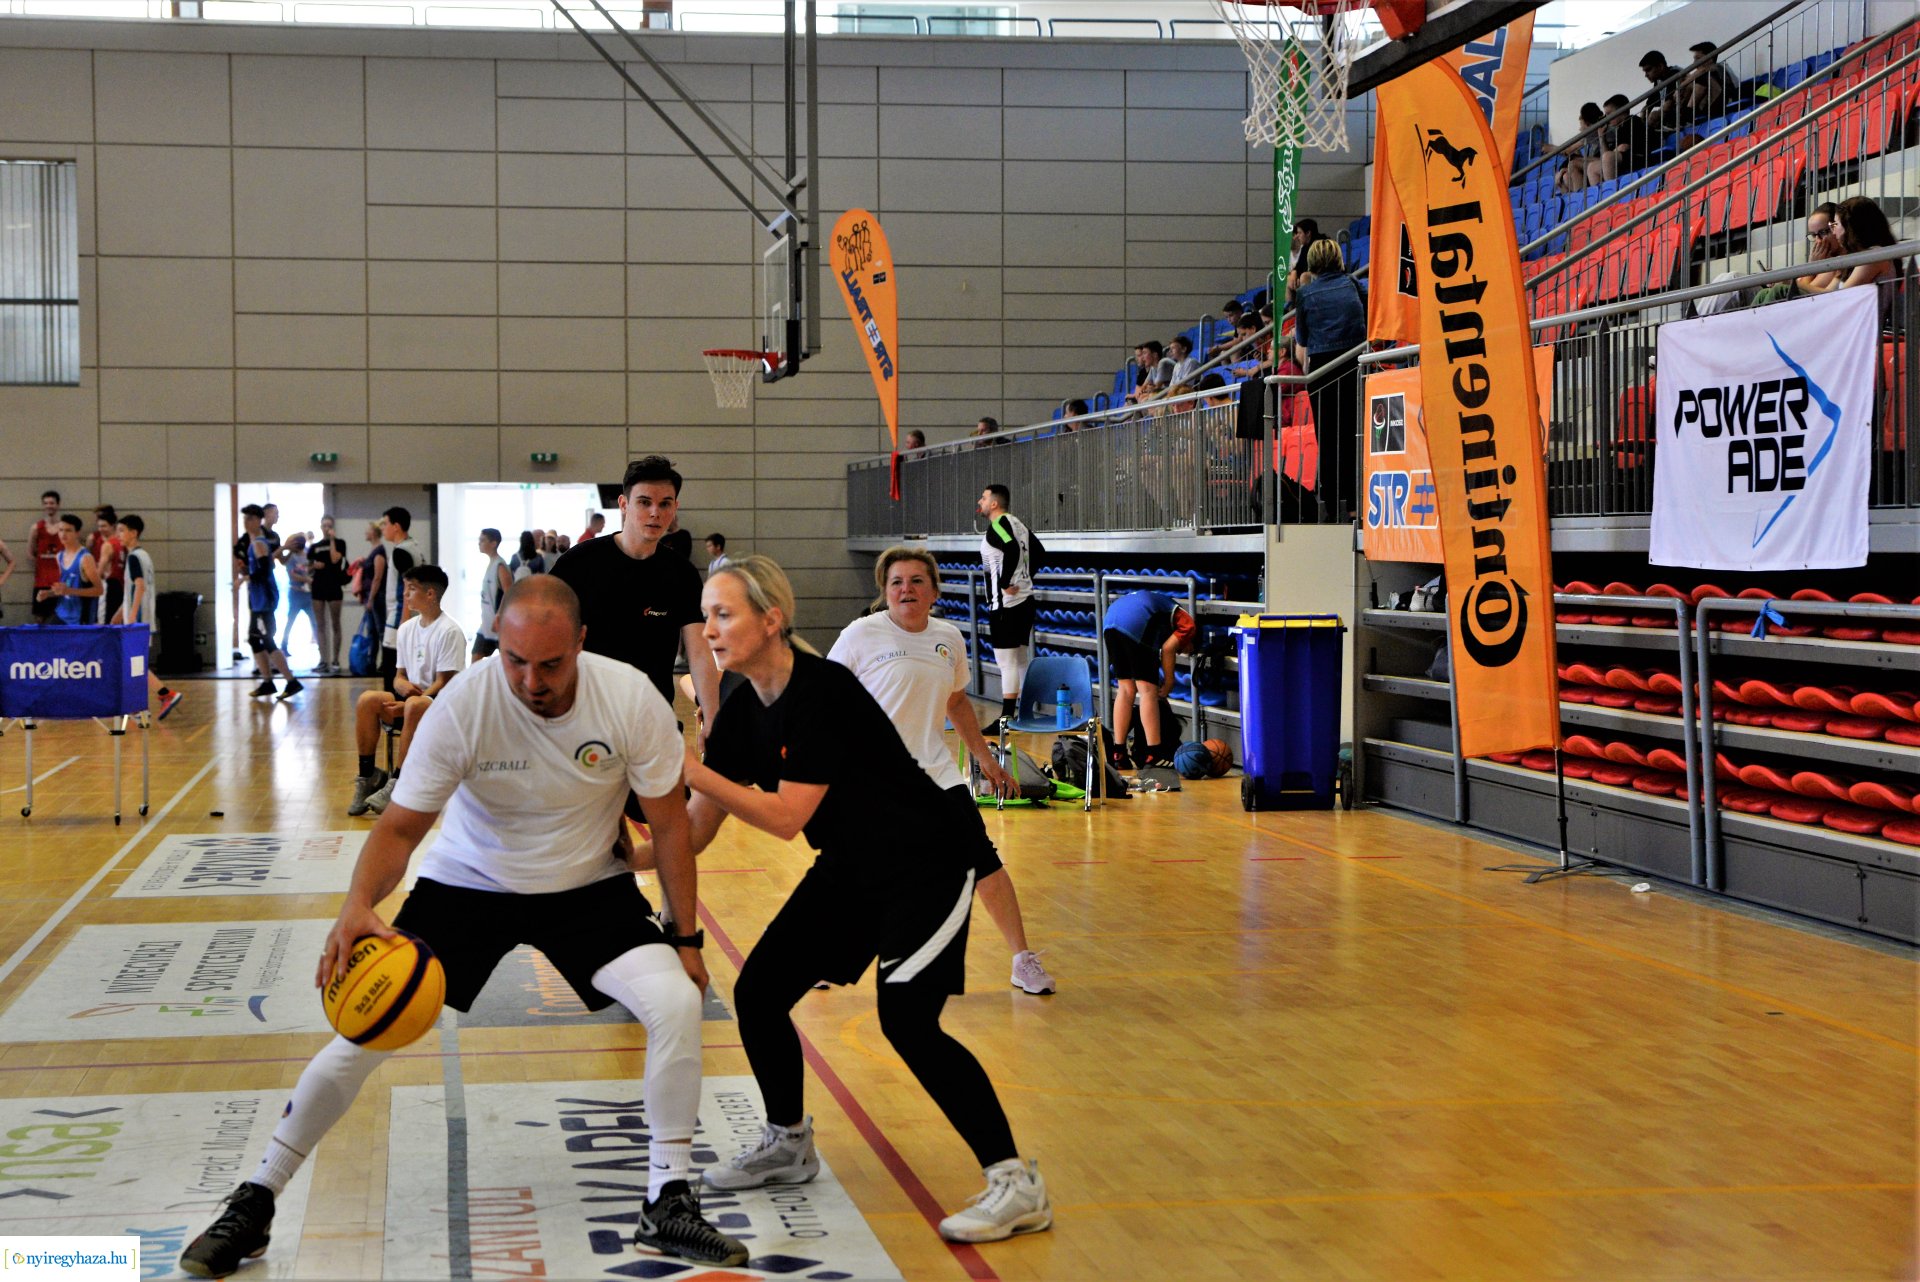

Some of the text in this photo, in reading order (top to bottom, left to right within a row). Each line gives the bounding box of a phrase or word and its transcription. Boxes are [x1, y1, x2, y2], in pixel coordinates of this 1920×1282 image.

[1674, 376, 1809, 439] POWER
[1728, 434, 1806, 494] ADE
[10, 657, 102, 680] molten
[101, 940, 183, 994] NYÍREGYHÁZI
[184, 928, 257, 992] SPORTCENTRUM
[368, 973, 390, 996] BALL
[201, 1116, 256, 1151] Munka.
